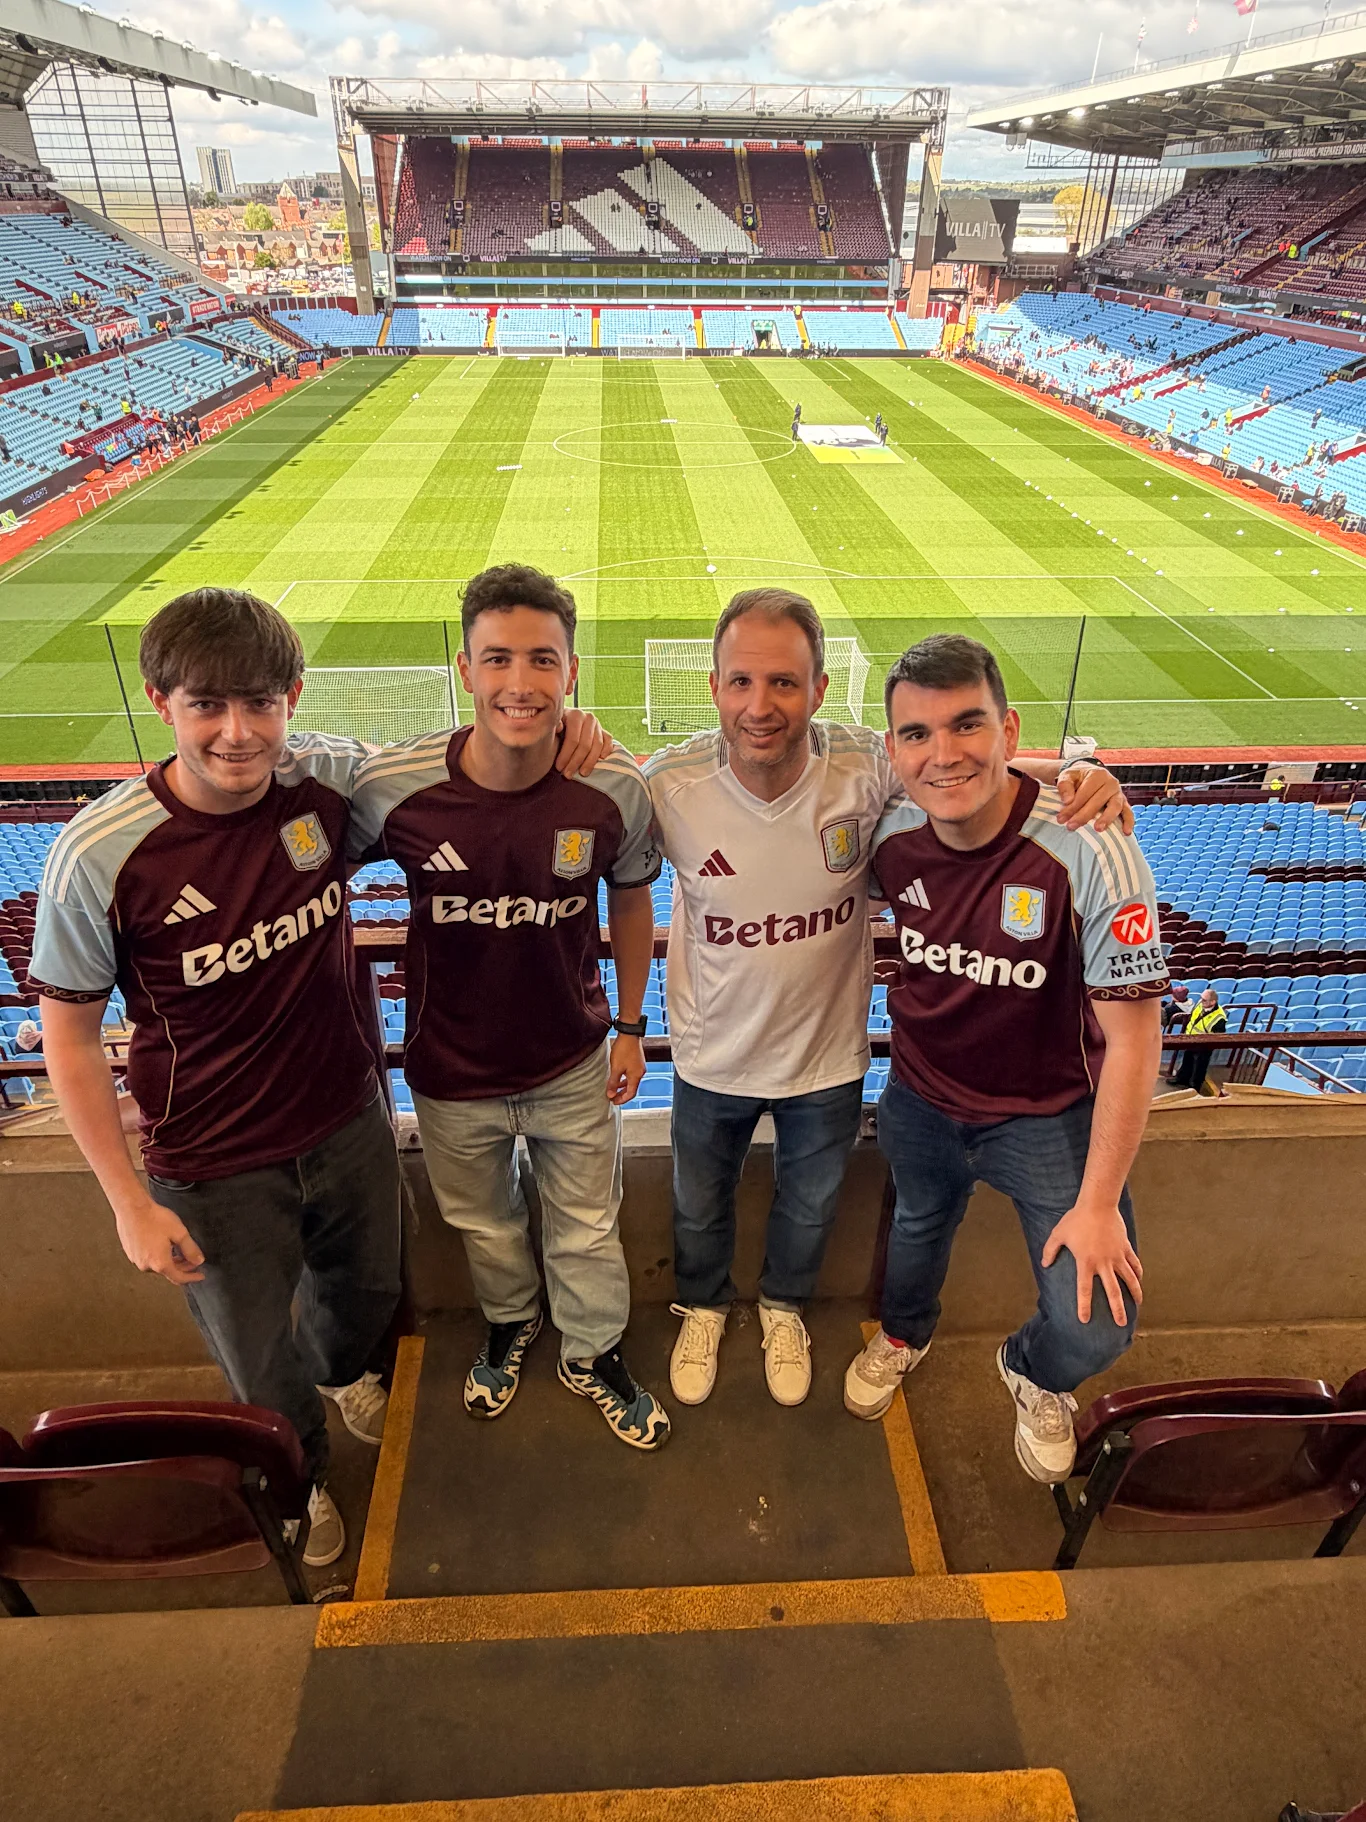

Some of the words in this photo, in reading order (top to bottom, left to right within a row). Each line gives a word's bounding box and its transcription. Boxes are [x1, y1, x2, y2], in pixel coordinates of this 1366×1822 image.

[1344, 144, 1352, 155] TO
[945, 221, 981, 238] VILLA
[989, 223, 1006, 238] TV
[366, 347, 394, 356] VILLA
[399, 347, 410, 356] TV
[432, 895, 588, 929] Betano
[704, 895, 855, 948] Betano
[182, 880, 342, 987] Betano
[1005, 925, 1023, 936] ASTON
[900, 925, 1047, 989] Betano
